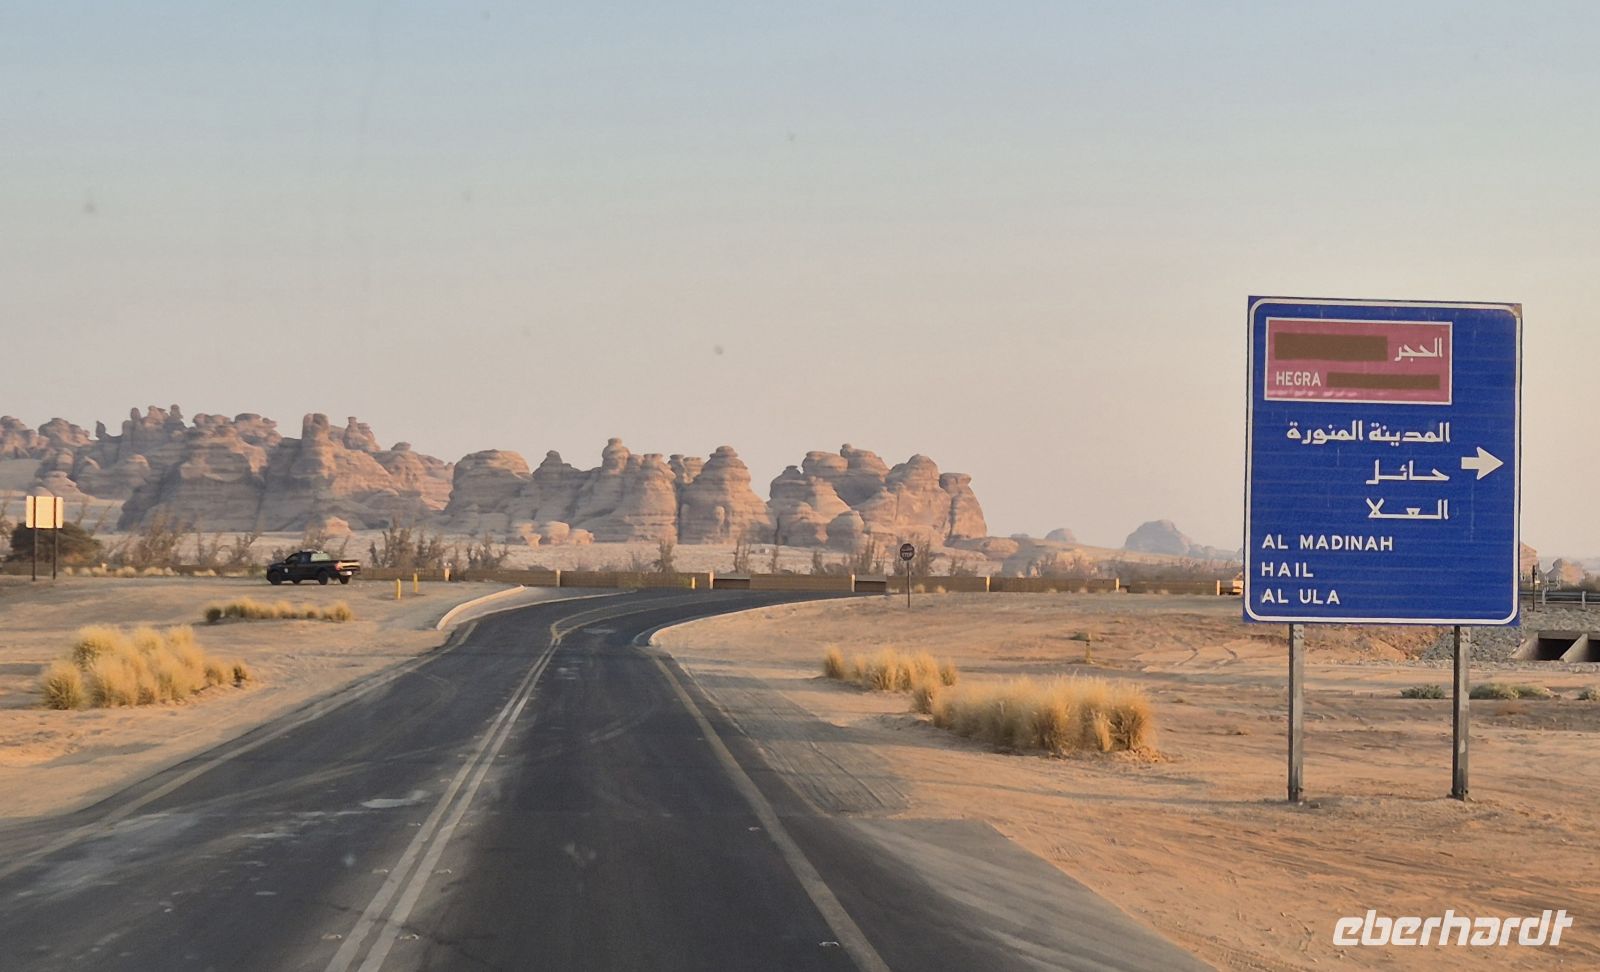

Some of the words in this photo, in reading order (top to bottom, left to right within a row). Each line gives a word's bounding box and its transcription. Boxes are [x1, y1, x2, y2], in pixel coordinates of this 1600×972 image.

[1394, 336, 1443, 362] الحجر
[1275, 371, 1322, 387] HEGRA
[1286, 419, 1363, 445] المنورة
[1368, 421, 1451, 447] المدينة
[1365, 459, 1450, 485] حائل
[1365, 497, 1449, 520] العلا
[1261, 534, 1289, 550] AL
[1299, 534, 1394, 552] MADINAH
[1261, 561, 1314, 578] HAIL
[1261, 588, 1289, 605] AL
[1299, 589, 1341, 606] ULA
